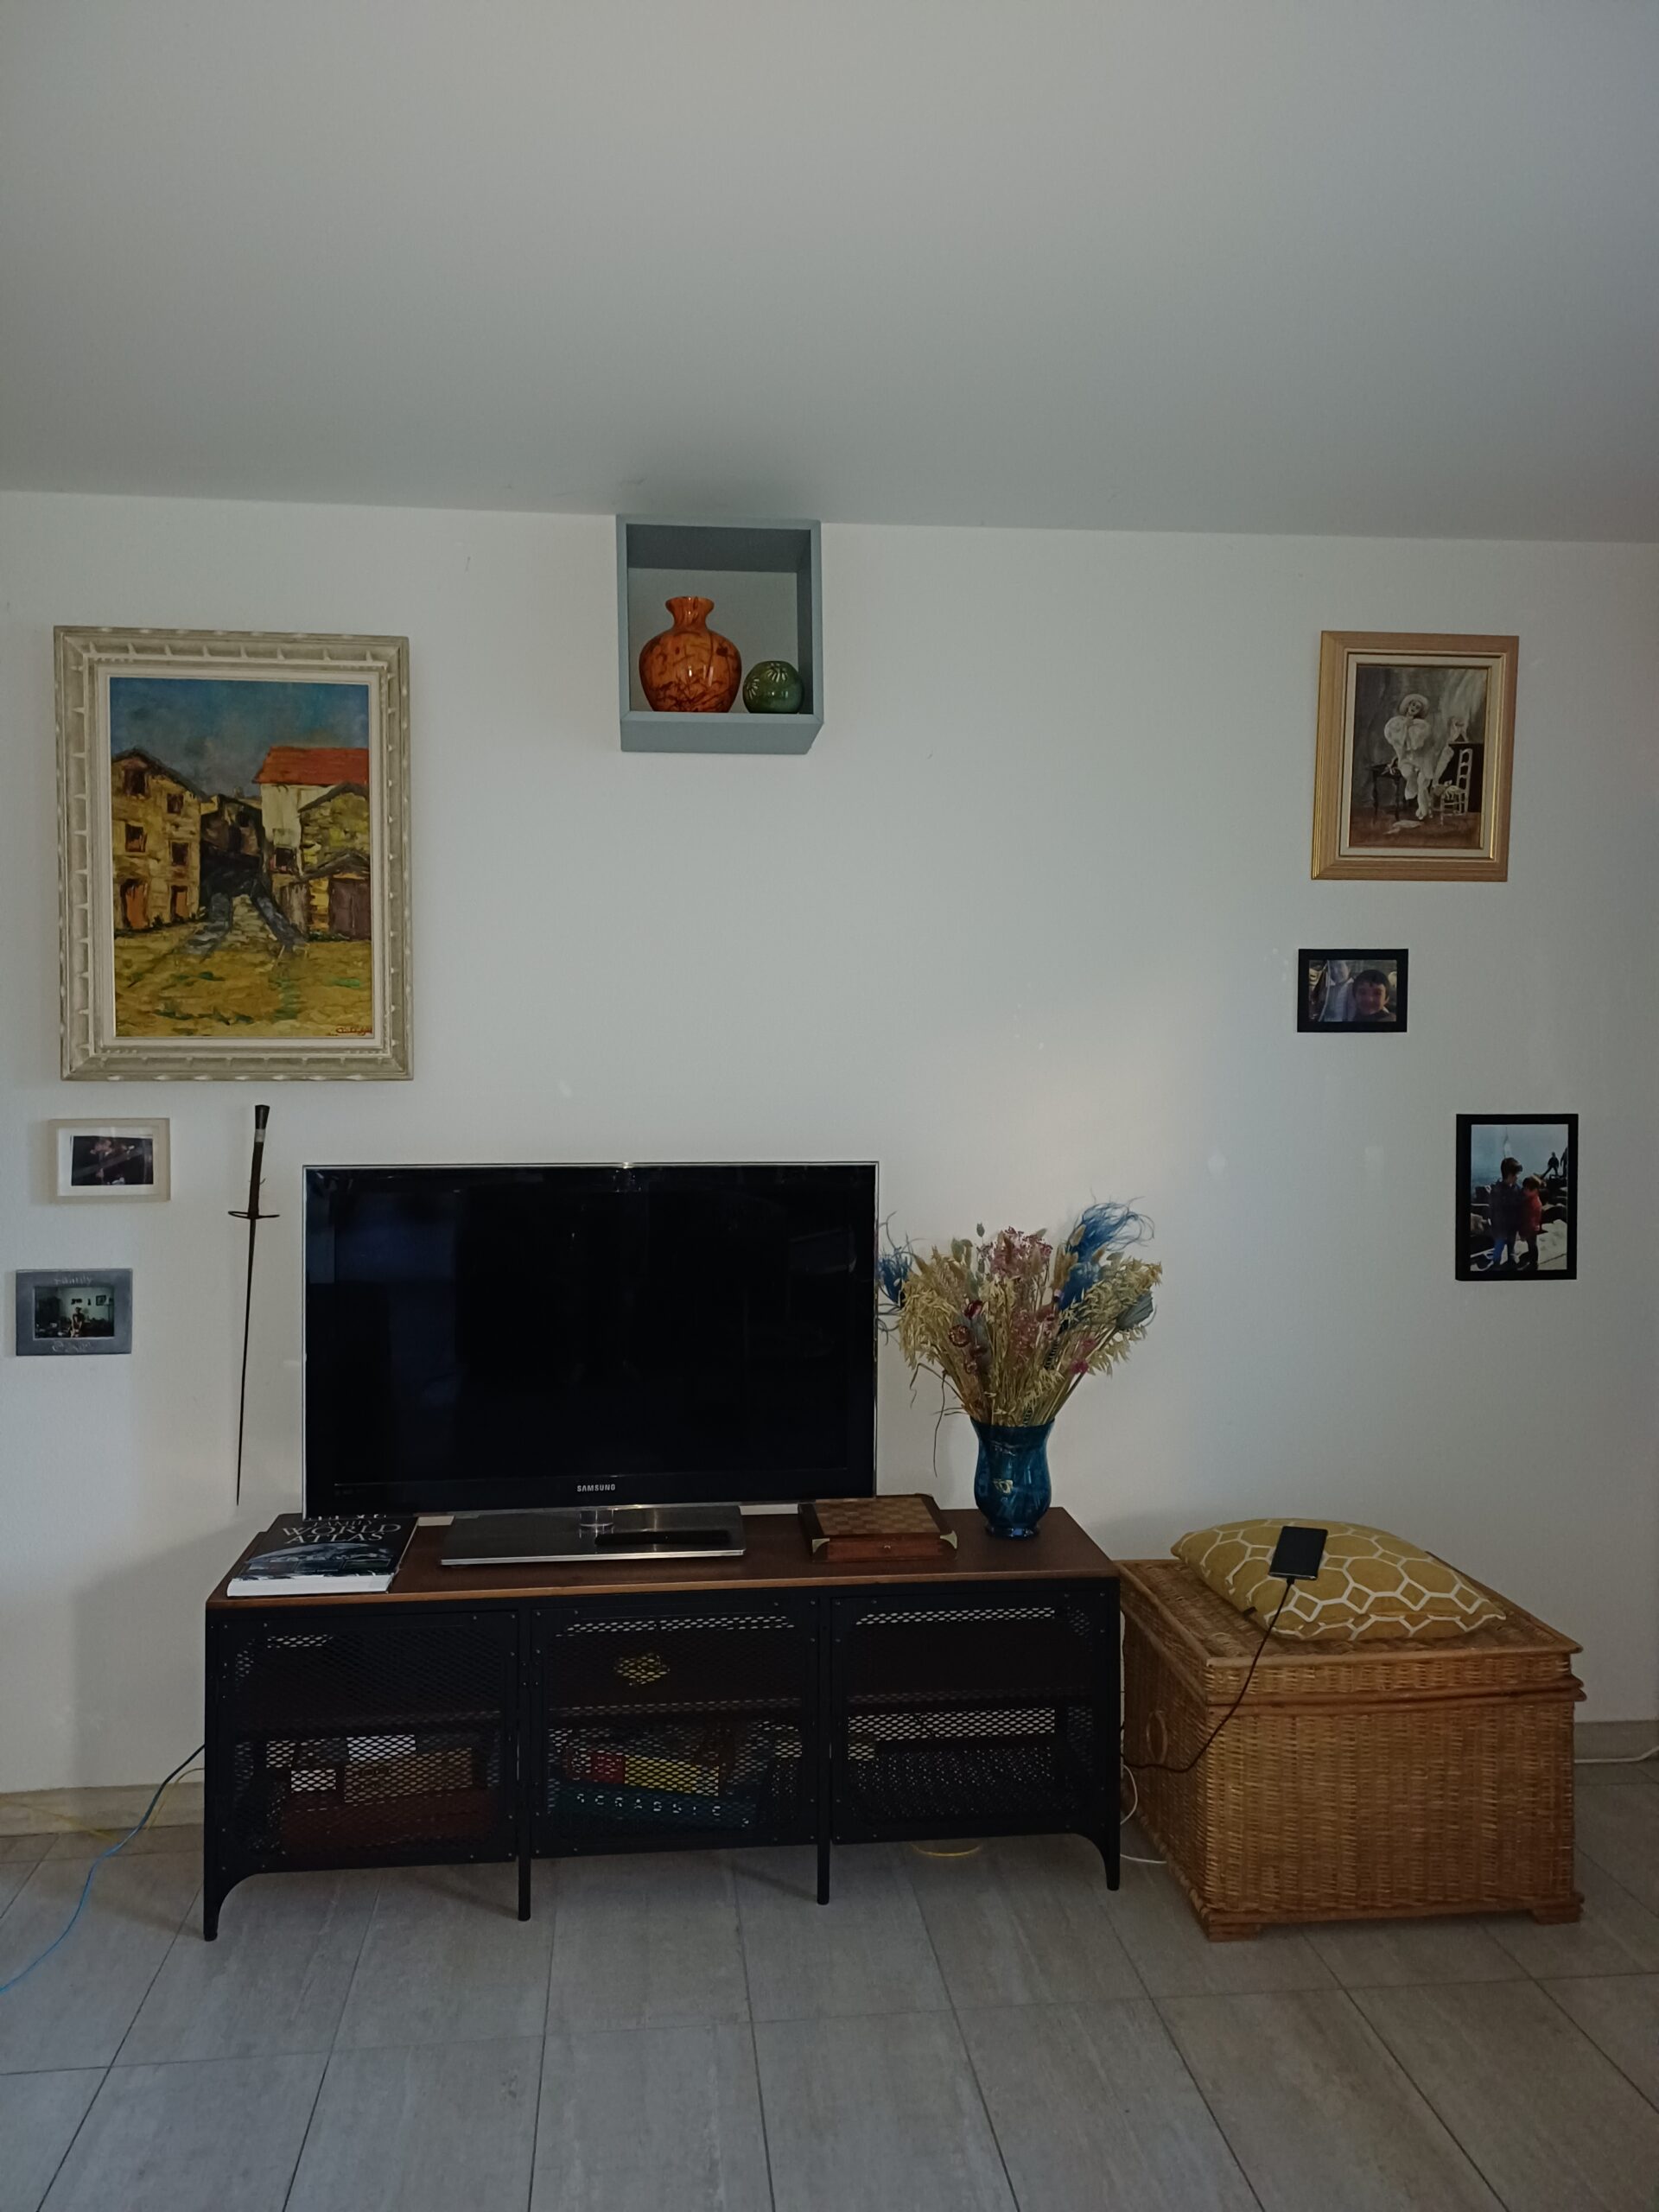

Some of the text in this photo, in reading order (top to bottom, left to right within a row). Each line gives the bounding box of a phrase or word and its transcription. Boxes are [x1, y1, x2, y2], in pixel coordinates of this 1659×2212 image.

[576, 1484, 616, 1492] SAMSUNG
[283, 1523, 402, 1536] WORLD
[285, 1533, 384, 1544] ATLAS
